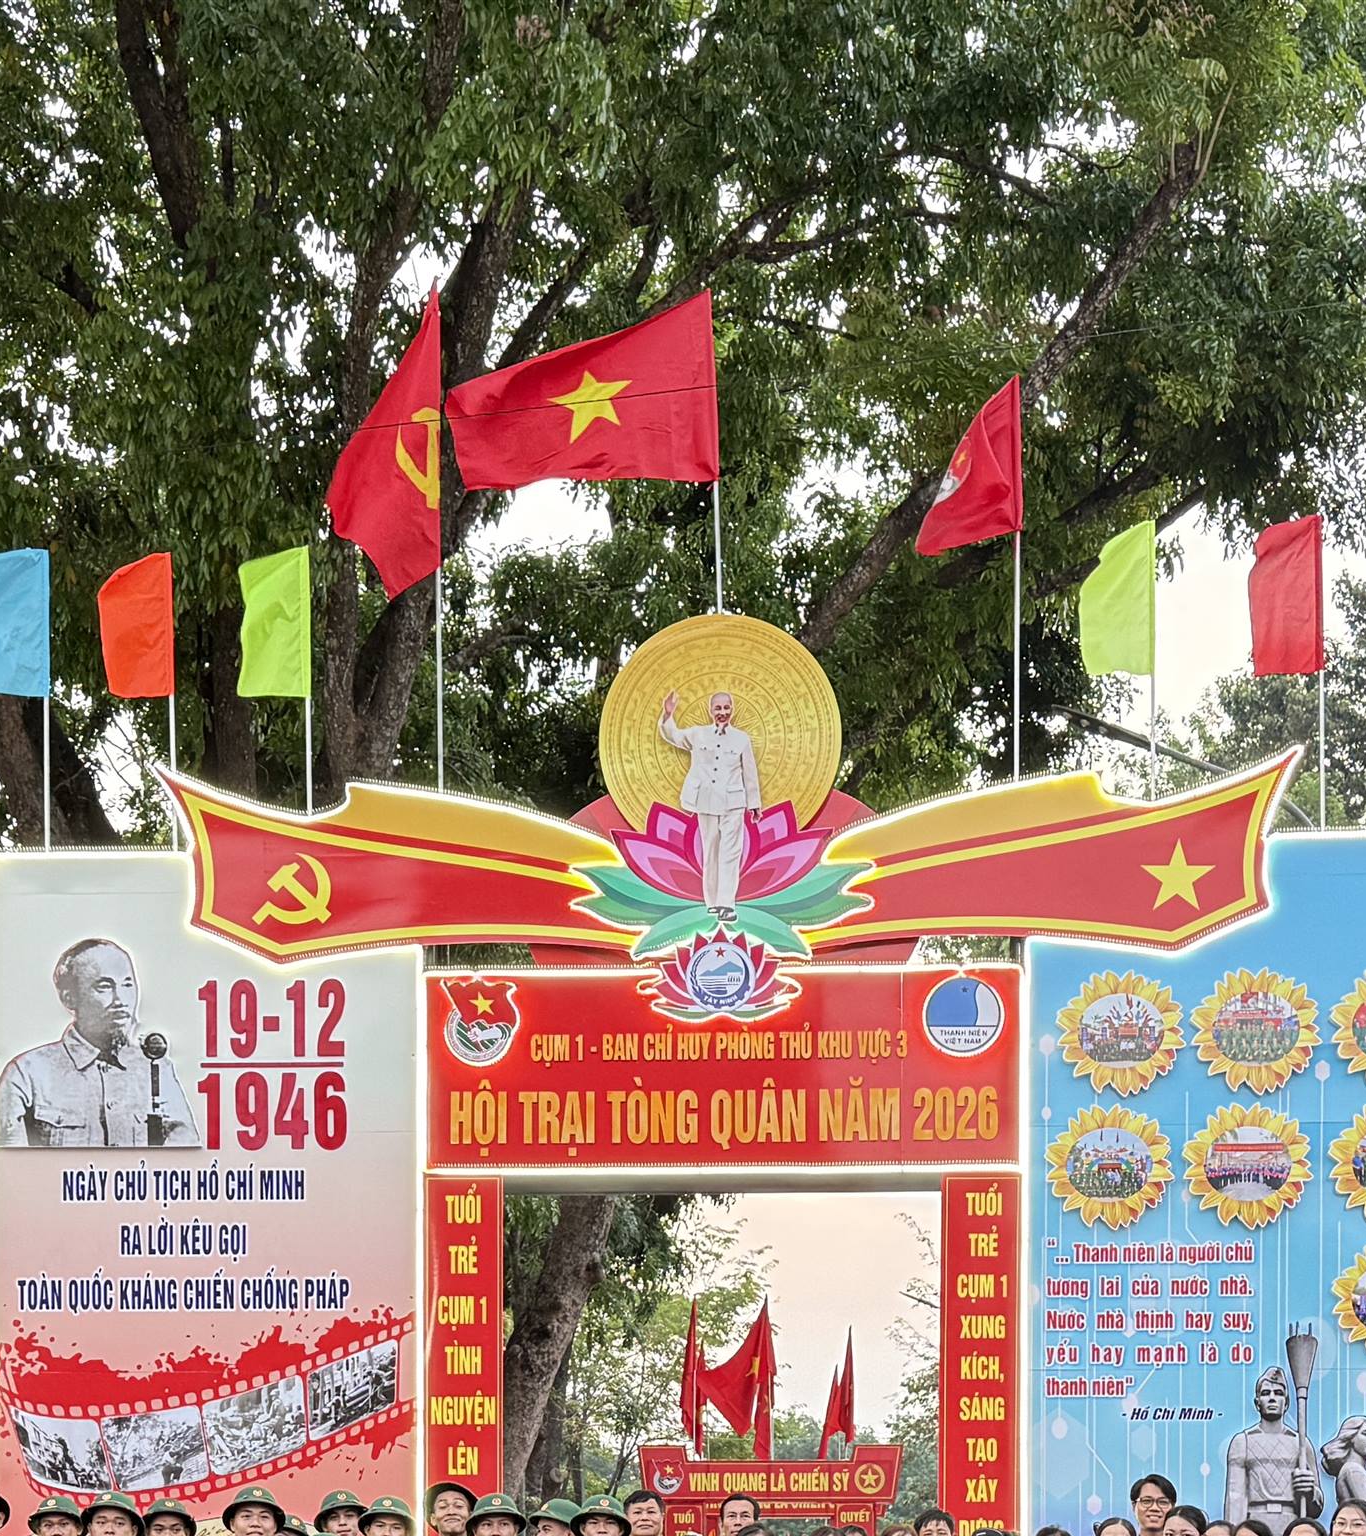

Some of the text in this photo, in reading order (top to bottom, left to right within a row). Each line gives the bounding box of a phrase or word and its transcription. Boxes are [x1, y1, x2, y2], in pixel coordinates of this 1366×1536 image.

[198, 979, 346, 1058] 19-12
[969, 1028, 987, 1036] NIÊN
[531, 1033, 570, 1068] CỤM
[575, 1034, 583, 1061] 1
[603, 1033, 638, 1061] BAN
[643, 1024, 672, 1061] CHỈ
[677, 1033, 711, 1061] HUY
[716, 1026, 774, 1060] PHÒNG
[780, 1022, 813, 1060] THỦ
[818, 1031, 852, 1059] KHU
[858, 1030, 891, 1064] VỰC
[897, 1031, 907, 1059] 3
[198, 1072, 347, 1150] 1946
[450, 1077, 999, 1156] HỘI TRẠI TÒNG QUÂN NĂM 2026
[62, 1159, 305, 1207] NGÀY CHỦ TỊCH HỒ CHÍ MINH
[445, 1183, 481, 1224] TUỔI
[966, 1183, 1003, 1217] TUỔI
[121, 1217, 247, 1262] RA LỜI KÊU GỌI
[448, 1236, 478, 1275] TRẺ
[968, 1225, 999, 1257] TRẺ
[1074, 1243, 1118, 1263] Thanh
[1123, 1243, 1154, 1262] niên
[1160, 1243, 1175, 1262] là
[1179, 1243, 1220, 1264] người
[1226, 1239, 1253, 1262] chủ
[18, 1268, 350, 1313] TOÀN QUỐC KHÁNG CHIẾN CHỐNG PHÁP
[957, 1274, 1008, 1303] CỤM 1
[1047, 1275, 1253, 1297] tương lai của nước nhà.
[438, 1295, 487, 1331] CỤM 1
[960, 1315, 1005, 1339] XUNG
[1047, 1309, 1252, 1333] Nước nhà thịnh hay suy,
[444, 1340, 482, 1375] TÌNH
[960, 1350, 1004, 1383] KÍCH,
[1047, 1339, 1253, 1367] yếu hay mạnh là do
[1047, 1377, 1087, 1395] thanh
[431, 1390, 496, 1431] NGUYỆN
[959, 1392, 1005, 1421] SÁNG
[1180, 1407, 1213, 1420] Minh
[447, 1440, 478, 1475] LÊN
[966, 1438, 998, 1468] TẠO
[689, 1466, 850, 1493] VINH QUANG LÀ CHIẾN SỸ
[965, 1474, 998, 1503] XÂY
